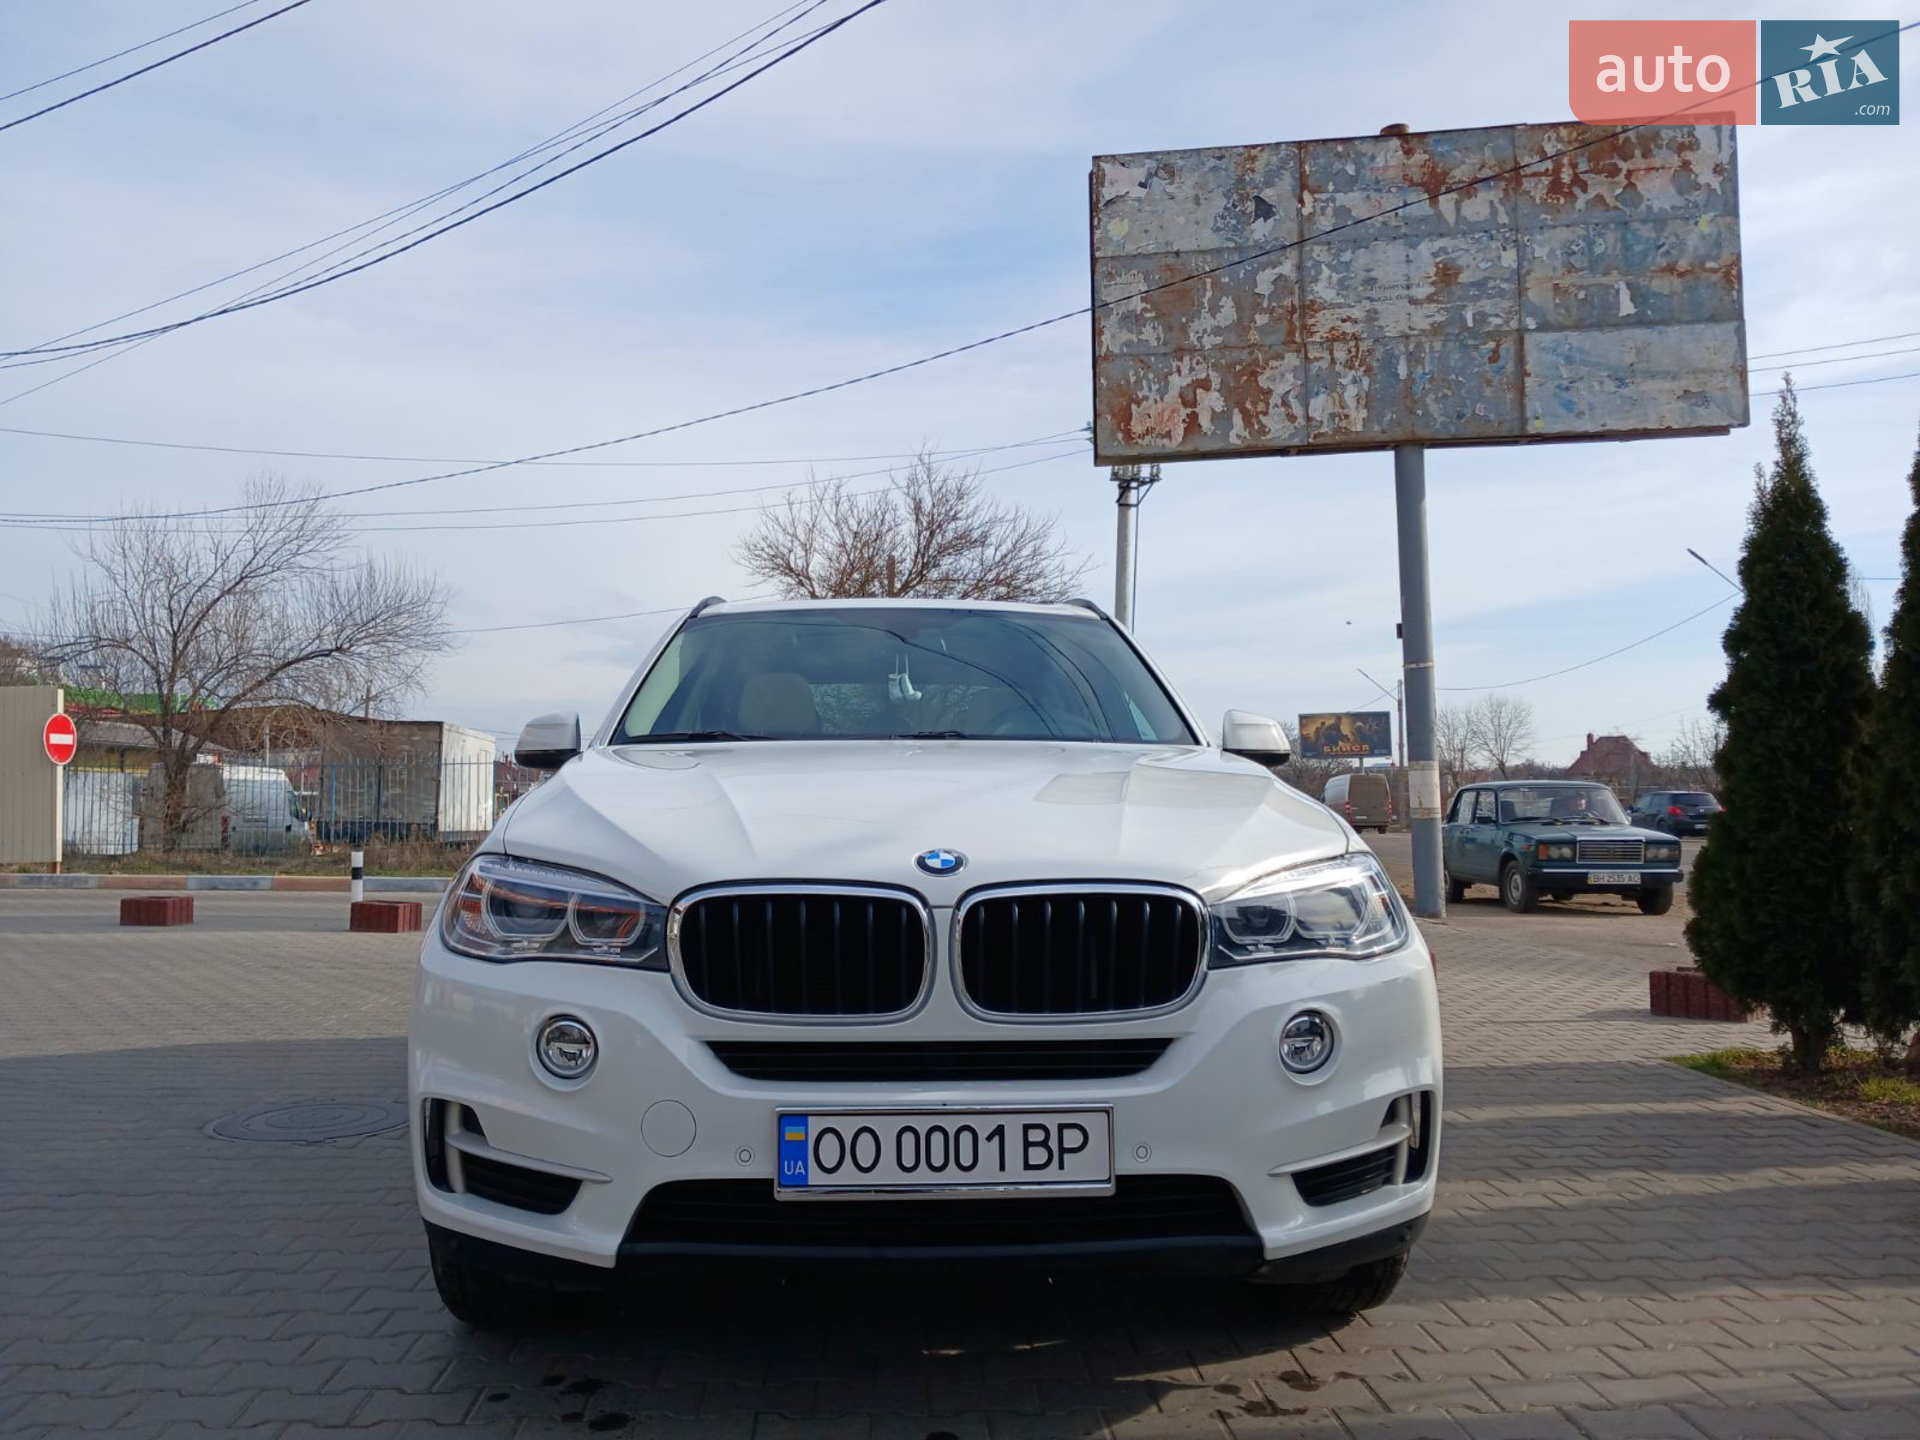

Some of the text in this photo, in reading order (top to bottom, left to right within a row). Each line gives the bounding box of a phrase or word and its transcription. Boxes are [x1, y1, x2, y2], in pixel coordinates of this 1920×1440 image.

[896, 1123, 1006, 1173] 0001
[1022, 1122, 1089, 1172] BP
[784, 1160, 805, 1175] UA
